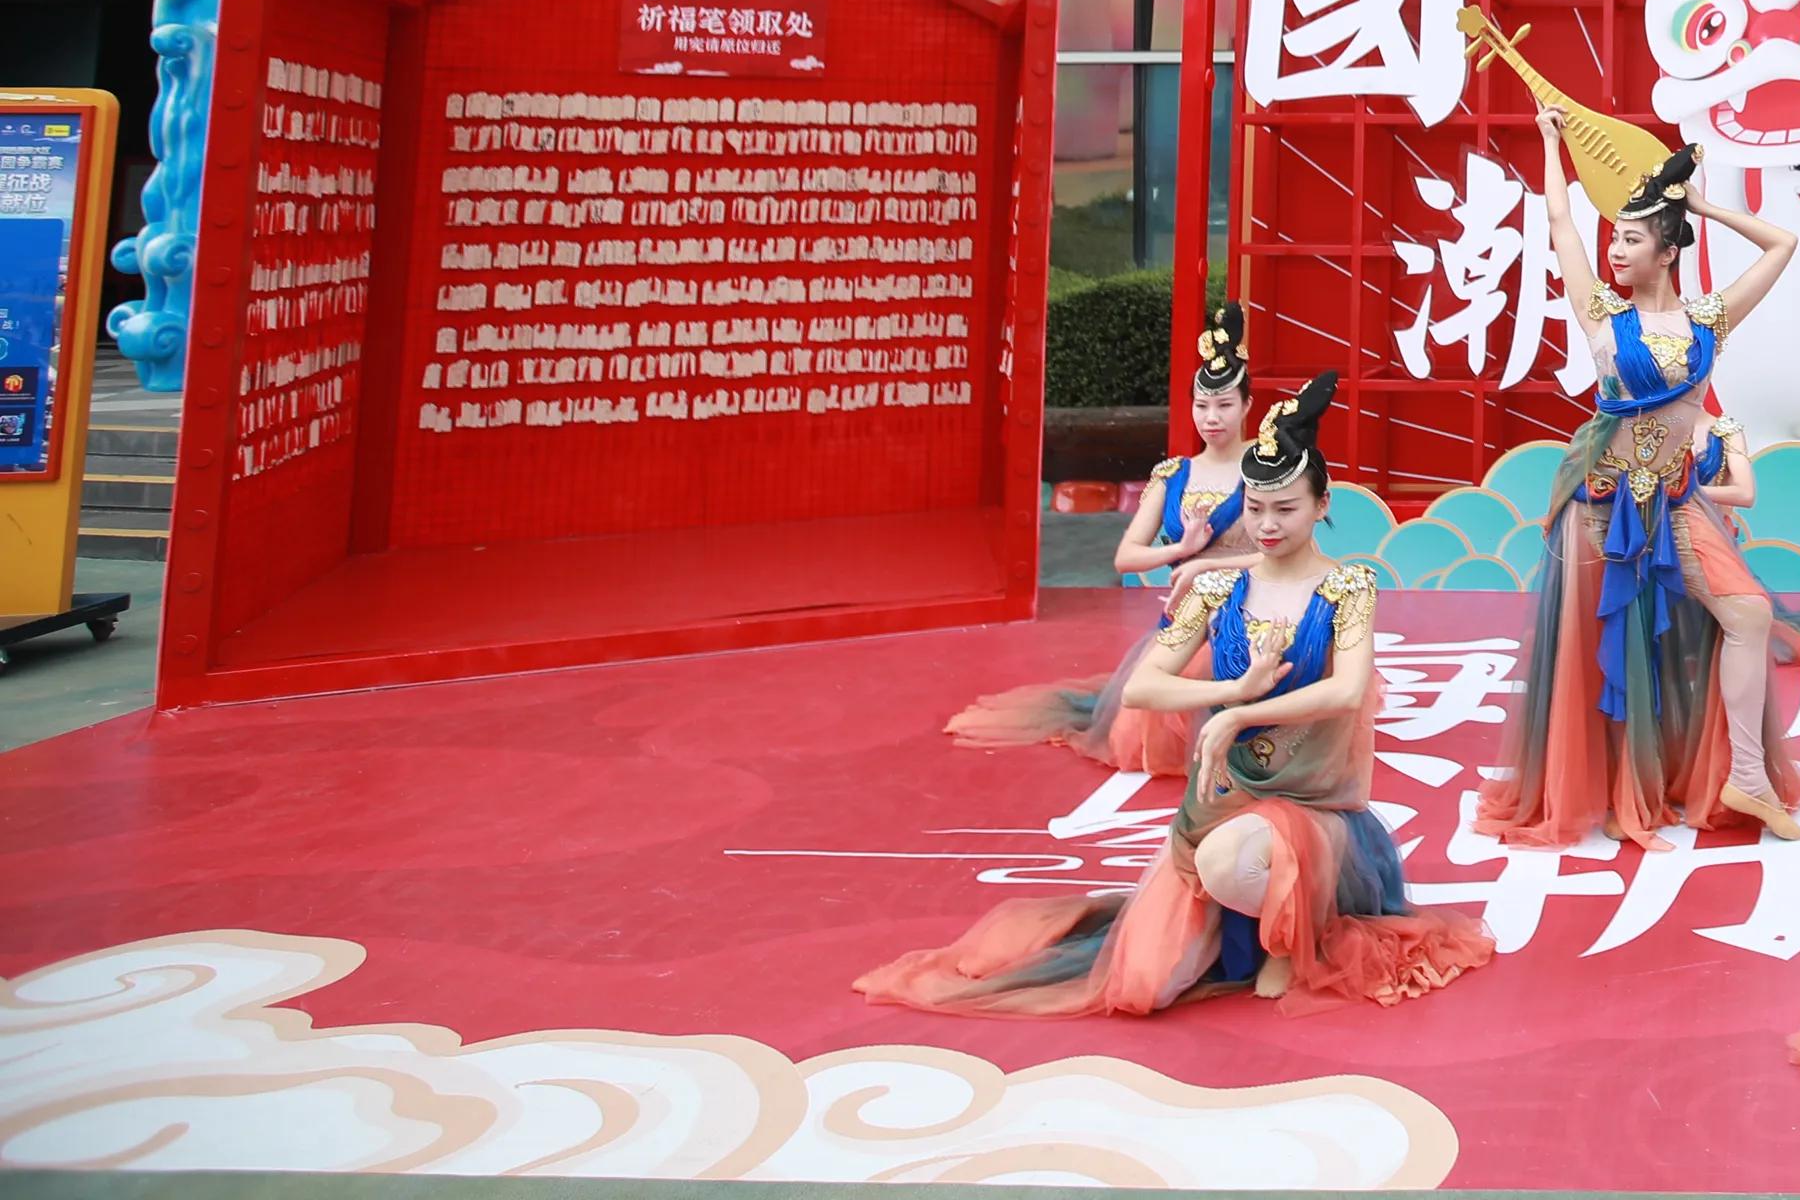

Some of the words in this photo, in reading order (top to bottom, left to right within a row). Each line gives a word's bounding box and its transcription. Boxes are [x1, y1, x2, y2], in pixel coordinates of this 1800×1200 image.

[637, 3, 814, 39] 祈福笔领取处
